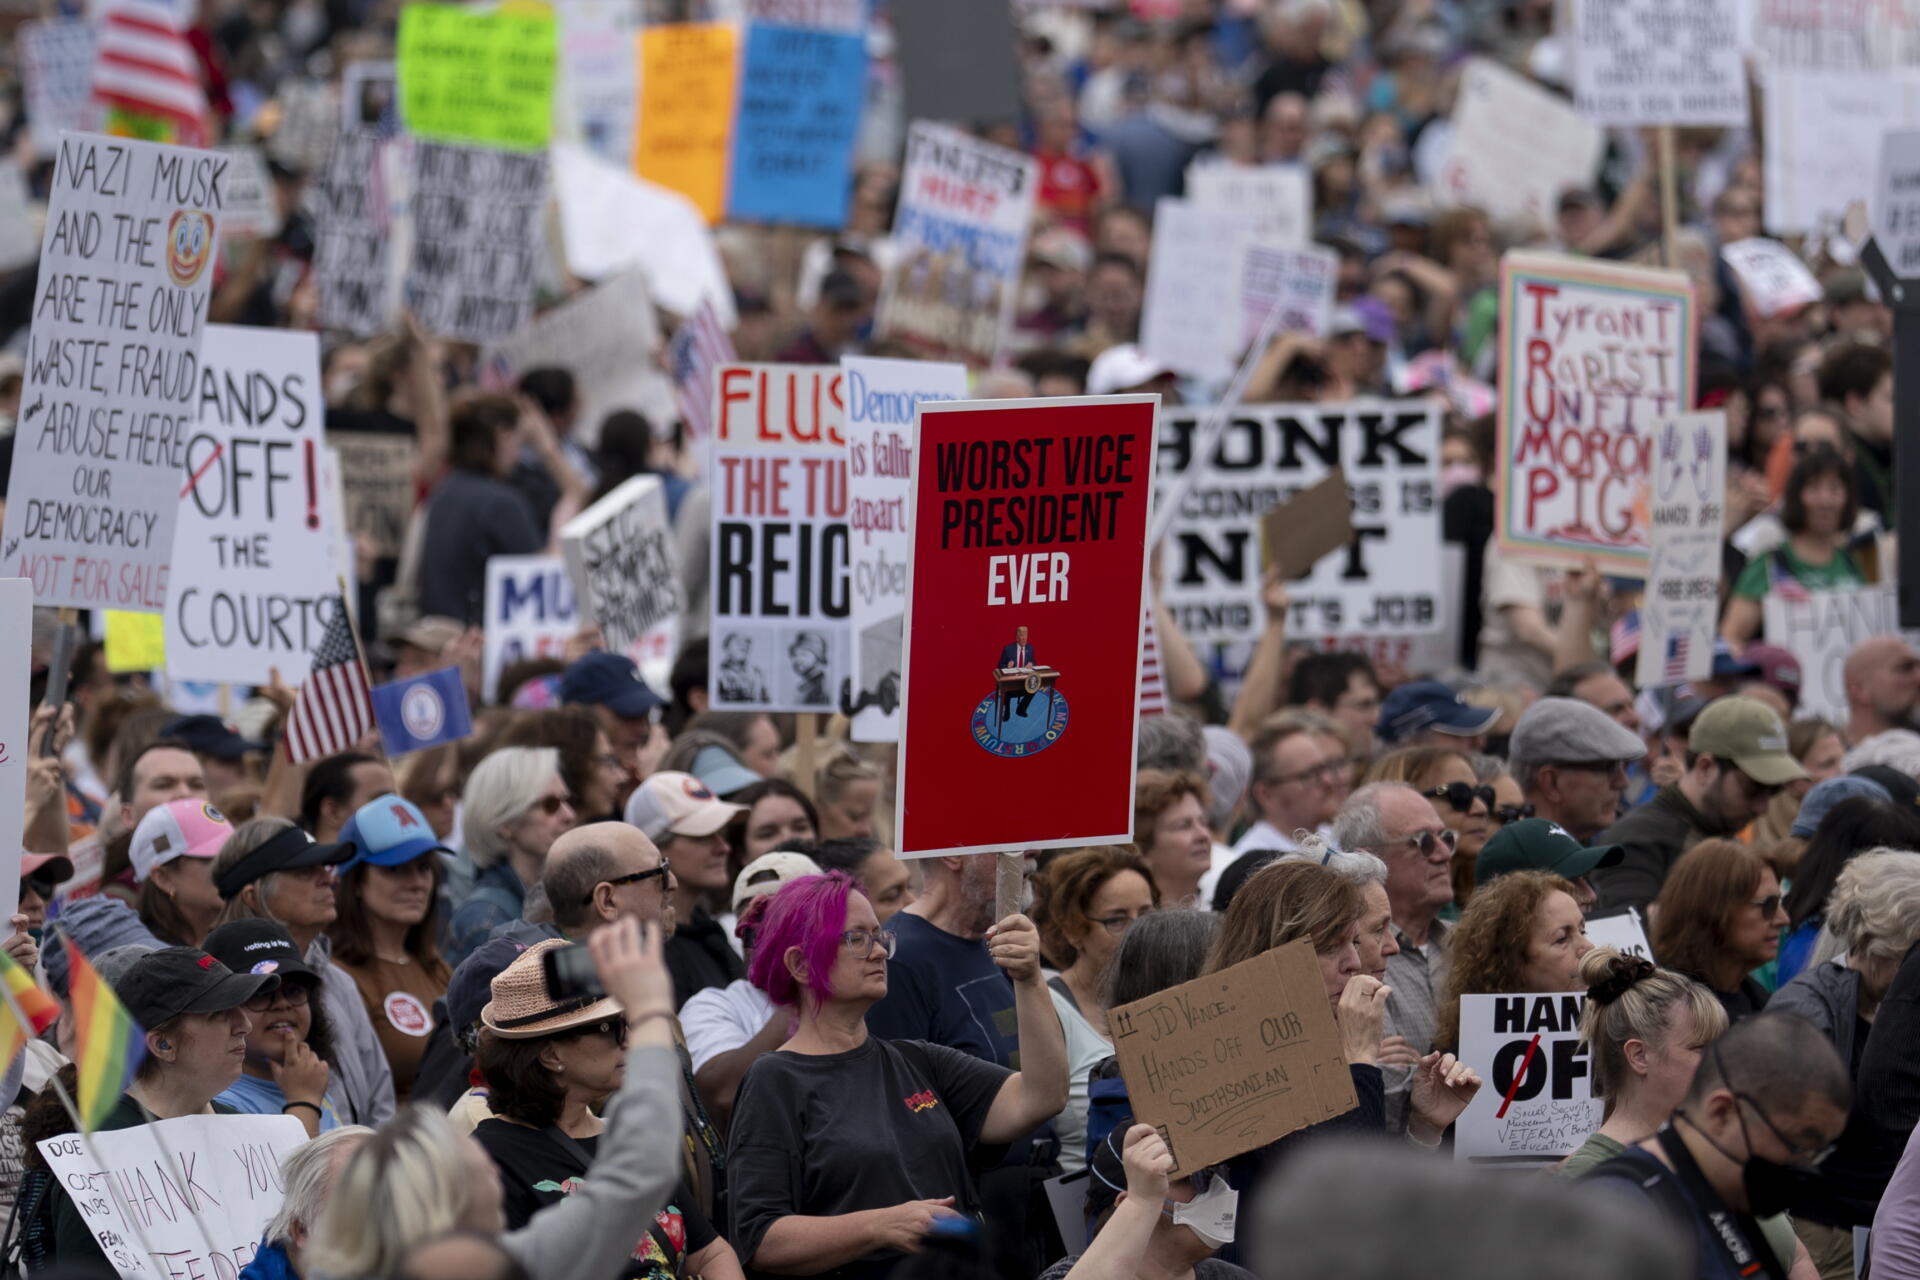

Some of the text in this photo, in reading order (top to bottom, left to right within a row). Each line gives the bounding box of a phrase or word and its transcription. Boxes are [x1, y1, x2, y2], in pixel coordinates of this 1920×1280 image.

[56, 139, 132, 197] NAZI
[151, 152, 229, 210] MUSK
[49, 209, 161, 268] AND THE
[37, 273, 205, 338] ARE THE ONLY
[30, 335, 199, 403] WASTE, FRAUD
[197, 364, 307, 432] ANDS
[36, 401, 124, 461] ABUSE
[125, 412, 188, 470] HERE
[717, 368, 846, 446] FLUS
[850, 430, 913, 480] is fallin
[936, 433, 1136, 492] WORST VICE
[1158, 413, 1428, 473] HONK
[72, 463, 112, 499] OUR
[180, 433, 320, 531] OFF!
[719, 457, 848, 518] THE TU
[1400, 482, 1434, 514] IS
[1528, 466, 1636, 538] PIG
[23, 498, 158, 550] DEMOCRACY
[851, 497, 907, 547] apart
[941, 491, 1124, 549] PRESIDENT
[210, 532, 272, 568] THE
[717, 522, 851, 618] REIC
[854, 548, 908, 606] cybe
[987, 552, 1071, 606] EVER
[1177, 527, 1388, 585] NT
[17, 554, 67, 598] NOT
[69, 556, 112, 602] FOR
[117, 560, 171, 609] SALE
[1290, 597, 1343, 627] T'S
[1362, 598, 1434, 627] JOB
[1784, 590, 1897, 653] HAN
[1137, 1001, 1178, 1042] JD
[1494, 995, 1586, 1034] HAN
[1141, 1052, 1209, 1094] HANDS
[1259, 1010, 1304, 1048] OUR
[1492, 1036, 1600, 1104] OF
[1168, 1063, 1289, 1126] SMITHSONIAN
[1511, 1100, 1594, 1120] Social Security
[47, 1138, 81, 1158] DOE
[1508, 1140, 1574, 1152] Education
[67, 1172, 99, 1194] CDC
[79, 1197, 111, 1218] NPS
[90, 1151, 222, 1234] THANK
[232, 1141, 286, 1201] YOU
[97, 1230, 128, 1250] FEMA
[113, 1249, 146, 1273] SSA
[148, 1240, 258, 1280] FEDE
[1708, 1211, 1752, 1264] SONY
